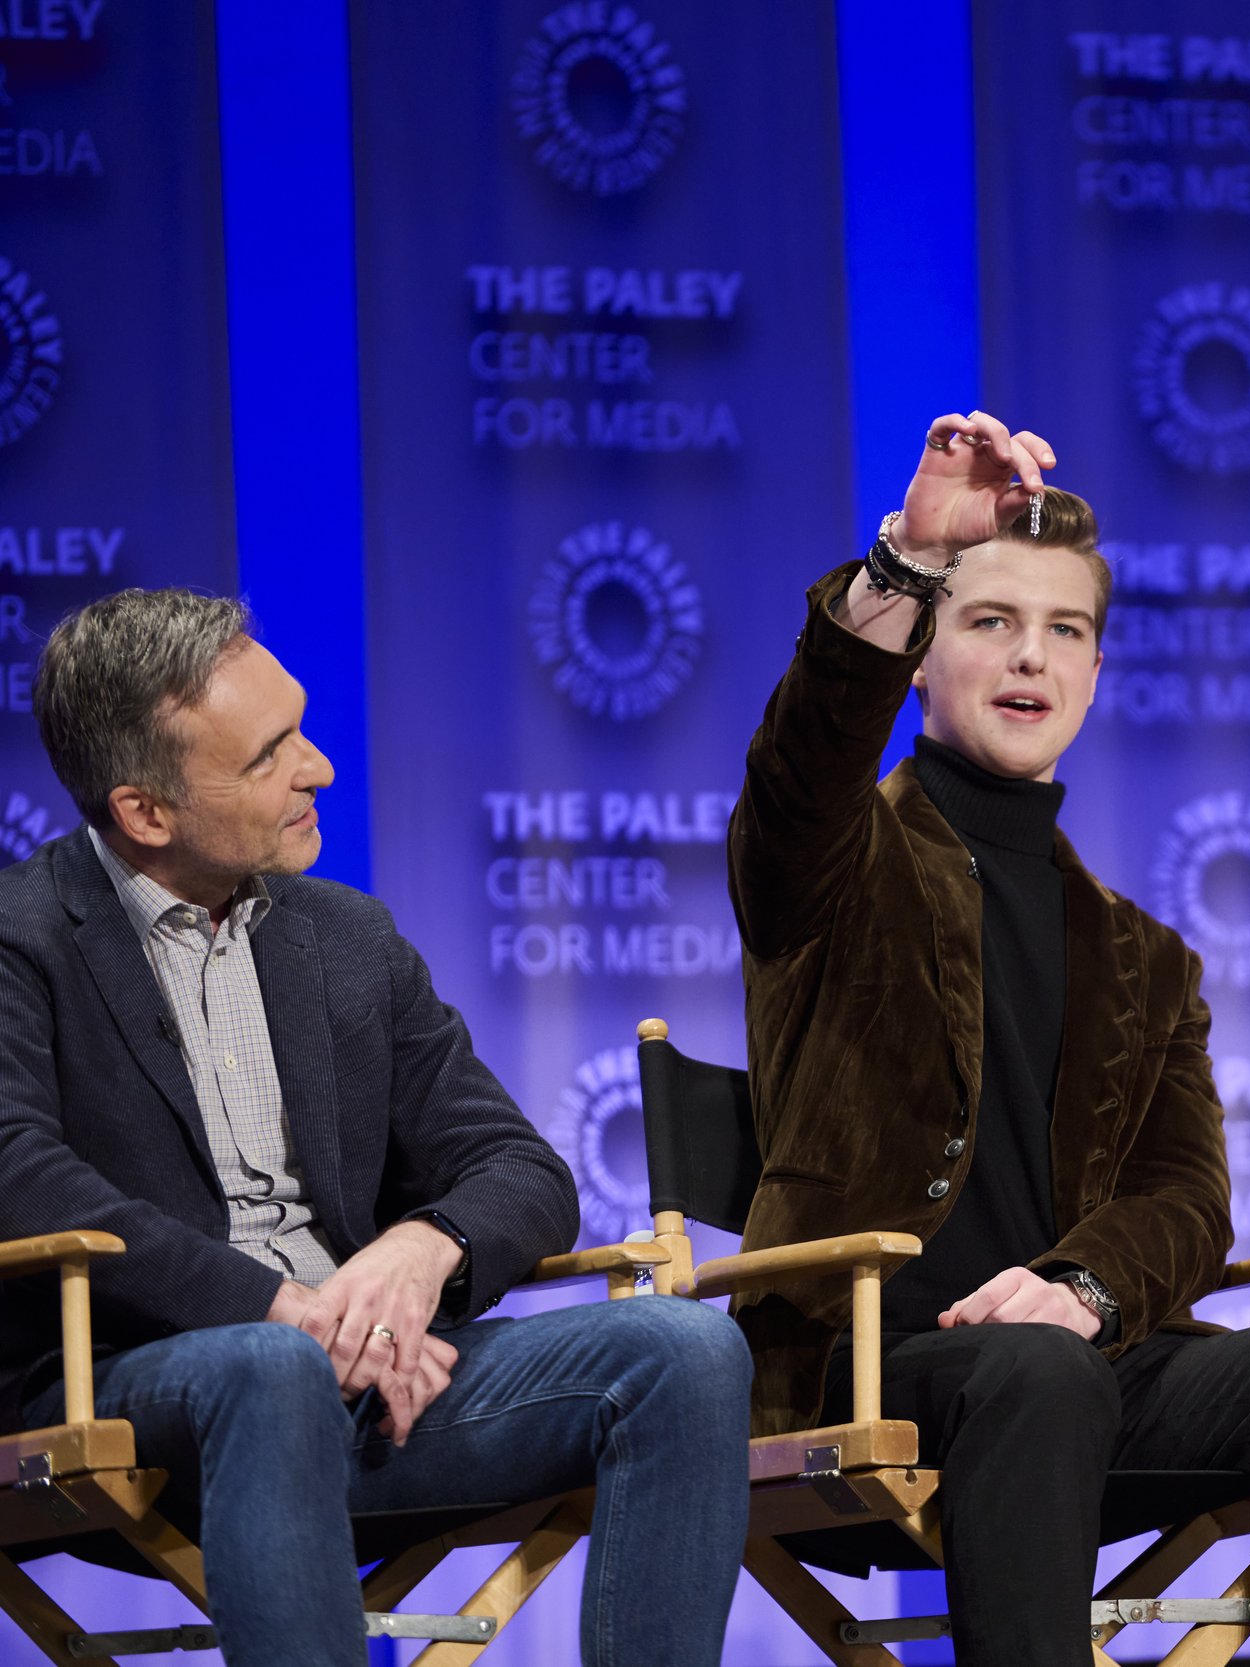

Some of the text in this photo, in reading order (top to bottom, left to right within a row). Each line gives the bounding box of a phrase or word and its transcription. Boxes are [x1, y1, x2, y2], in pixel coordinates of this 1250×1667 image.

[0, 0, 104, 40] LEY
[1067, 31, 1173, 81] THE
[1076, 160, 1179, 211] FOR
[465, 264, 744, 319] THE PALEY
[470, 330, 654, 384] CENTER
[474, 397, 742, 452] FOR MEDIA
[482, 791, 589, 841] THE
[485, 857, 671, 909] CENTER
[490, 923, 594, 976] FOR
